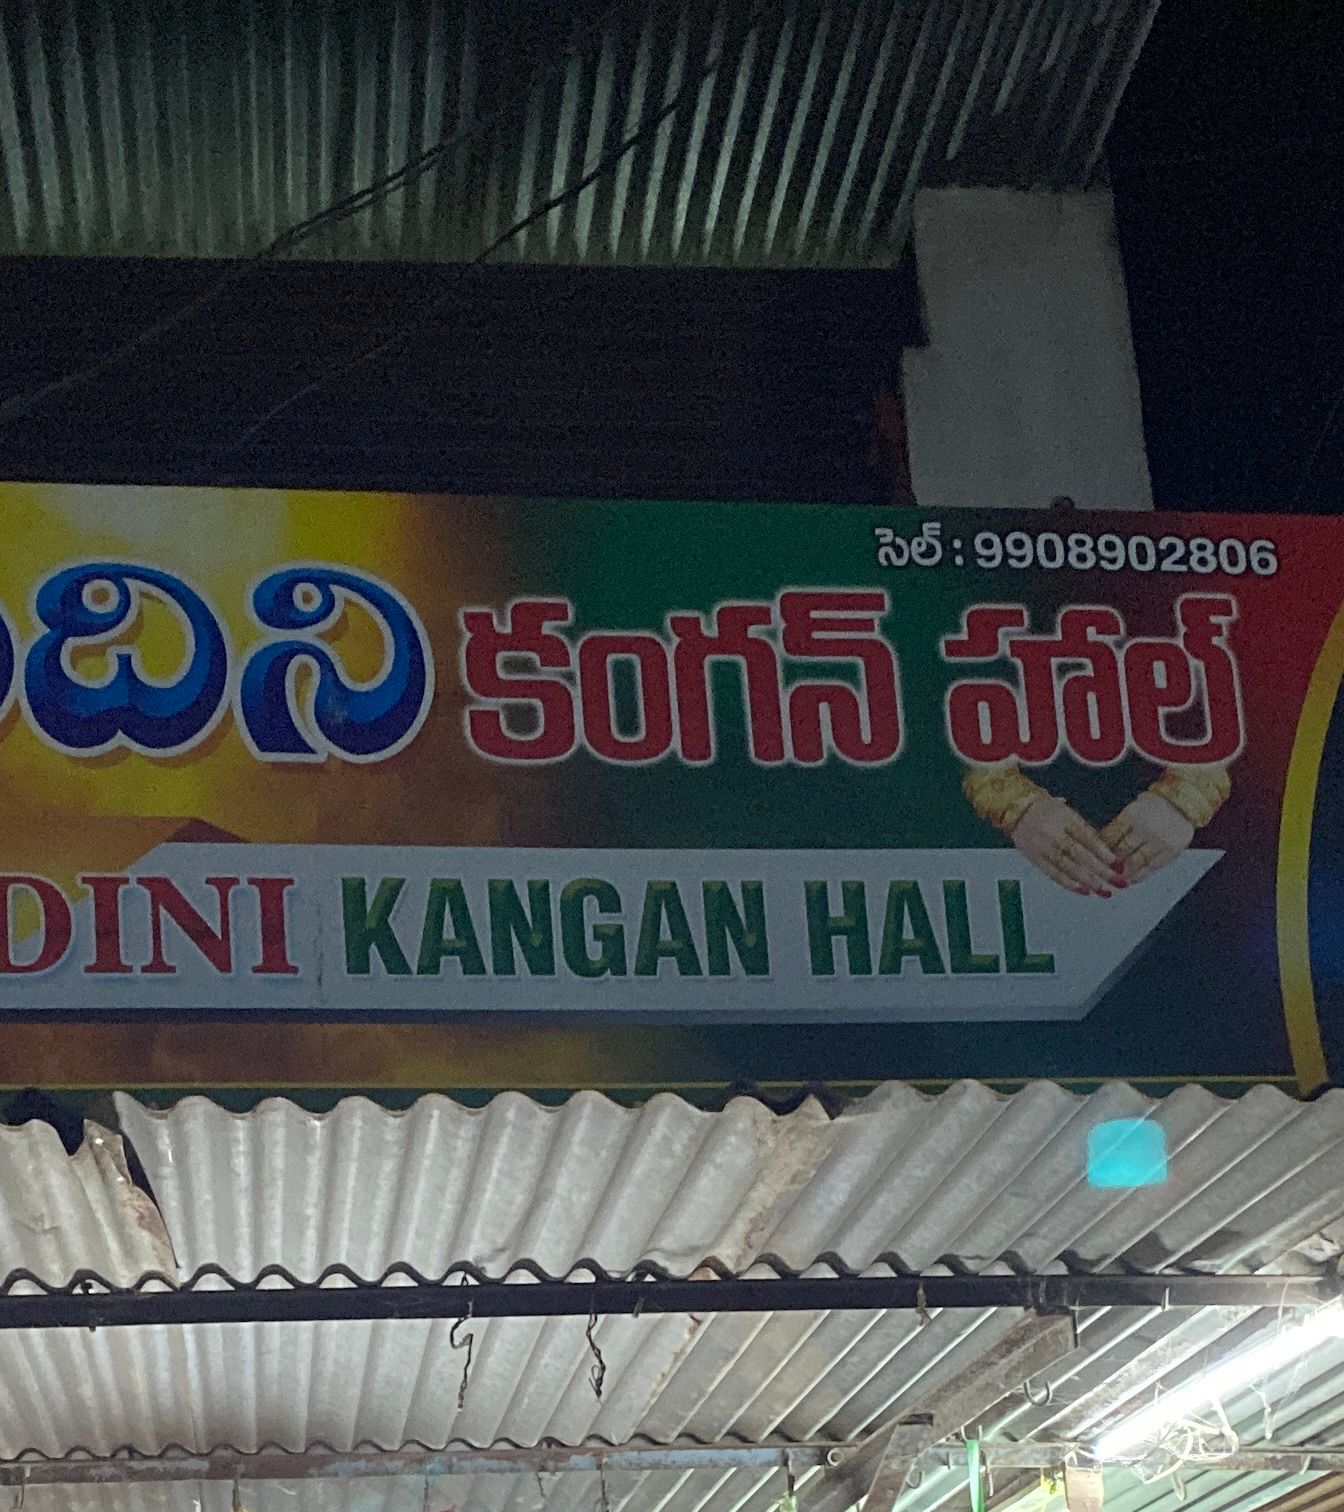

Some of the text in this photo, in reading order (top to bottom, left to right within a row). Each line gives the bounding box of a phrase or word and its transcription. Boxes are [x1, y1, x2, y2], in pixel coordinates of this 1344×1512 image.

[975, 531, 1279, 576] 9908902806
[459, 588, 902, 766] కంగన్
[940, 591, 1247, 766] హాల్
[341, 876, 771, 978] KANGAN
[805, 878, 1056, 977] HALL
